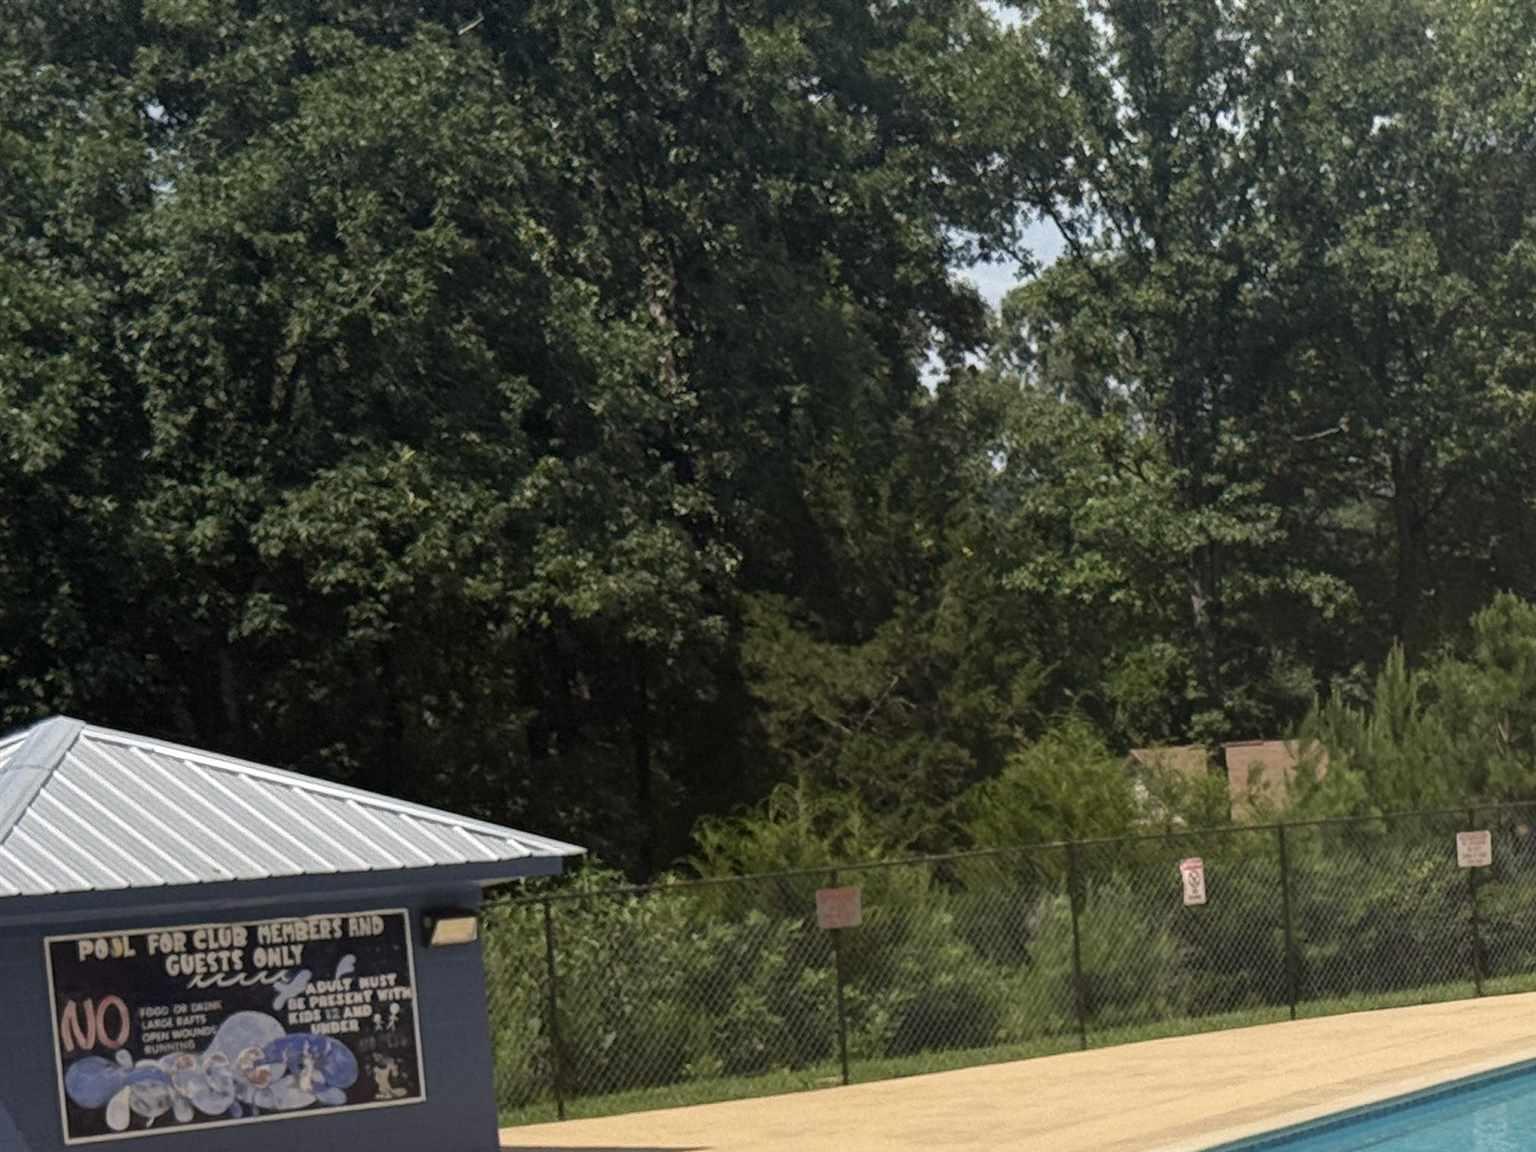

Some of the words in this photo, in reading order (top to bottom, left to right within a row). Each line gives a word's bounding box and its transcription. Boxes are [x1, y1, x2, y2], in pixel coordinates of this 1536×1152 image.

[78, 935, 136, 962] POOL
[147, 931, 187, 956] FOR
[192, 926, 249, 950] CLUB
[257, 917, 342, 946] MEMBERS
[349, 916, 384, 937] AND
[165, 949, 244, 976] GUESTS
[253, 944, 304, 969] ONLY
[305, 977, 352, 995] ADULT
[358, 973, 397, 989] MUST
[288, 998, 306, 1010] BE
[309, 990, 373, 1009] PRESENT
[376, 986, 413, 1001] WITH
[61, 994, 130, 1052] NO
[288, 1009, 321, 1025] KIDS
[343, 1004, 372, 1019] AND
[142, 1031, 170, 1043] OPEN
[311, 1019, 360, 1034] UNDER
